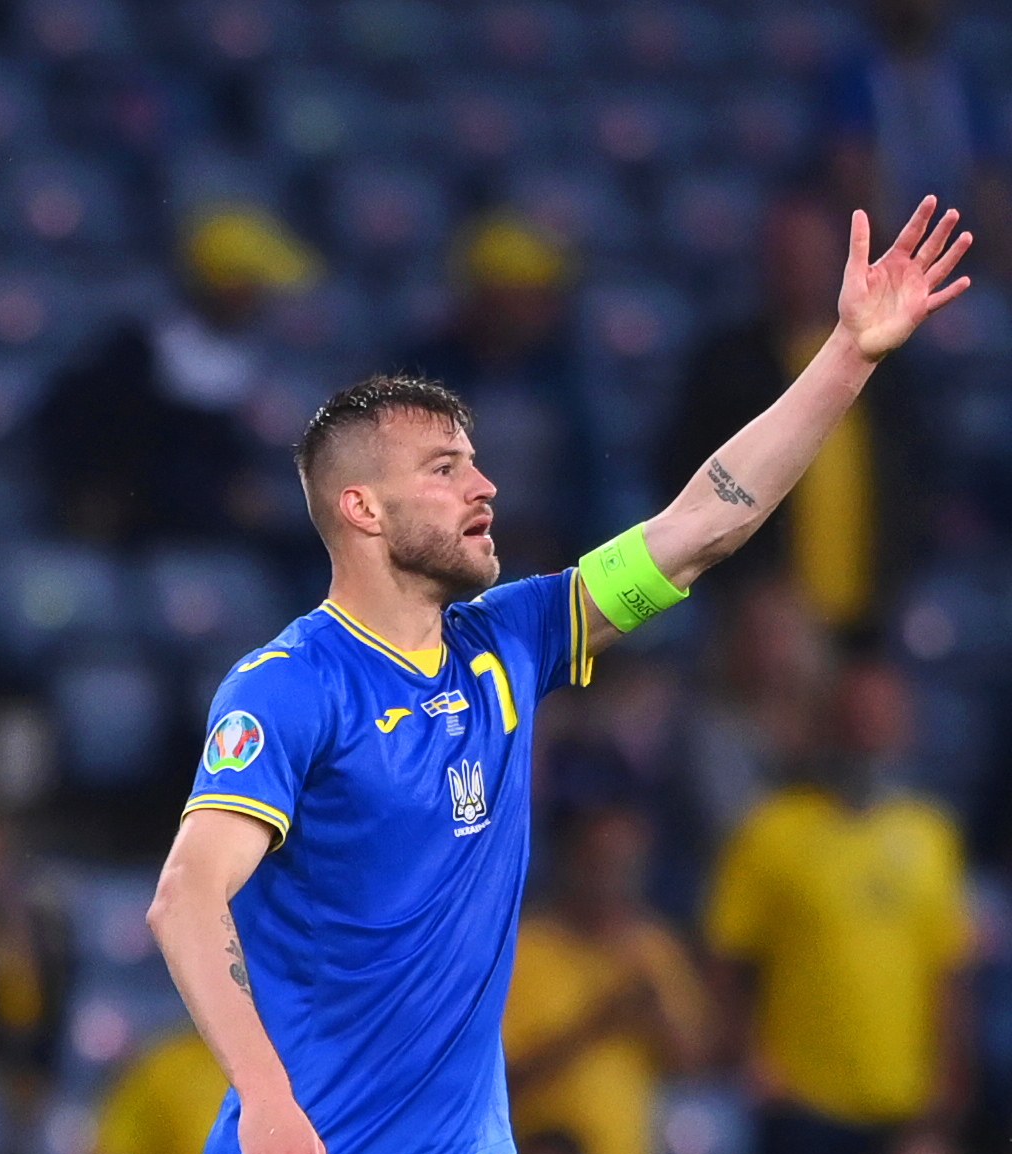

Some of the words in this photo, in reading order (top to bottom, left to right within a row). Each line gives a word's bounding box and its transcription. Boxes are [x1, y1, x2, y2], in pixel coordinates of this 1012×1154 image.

[622, 588, 658, 617] SPECT
[469, 651, 518, 735] 7
[453, 819, 491, 837] UKRAINE
